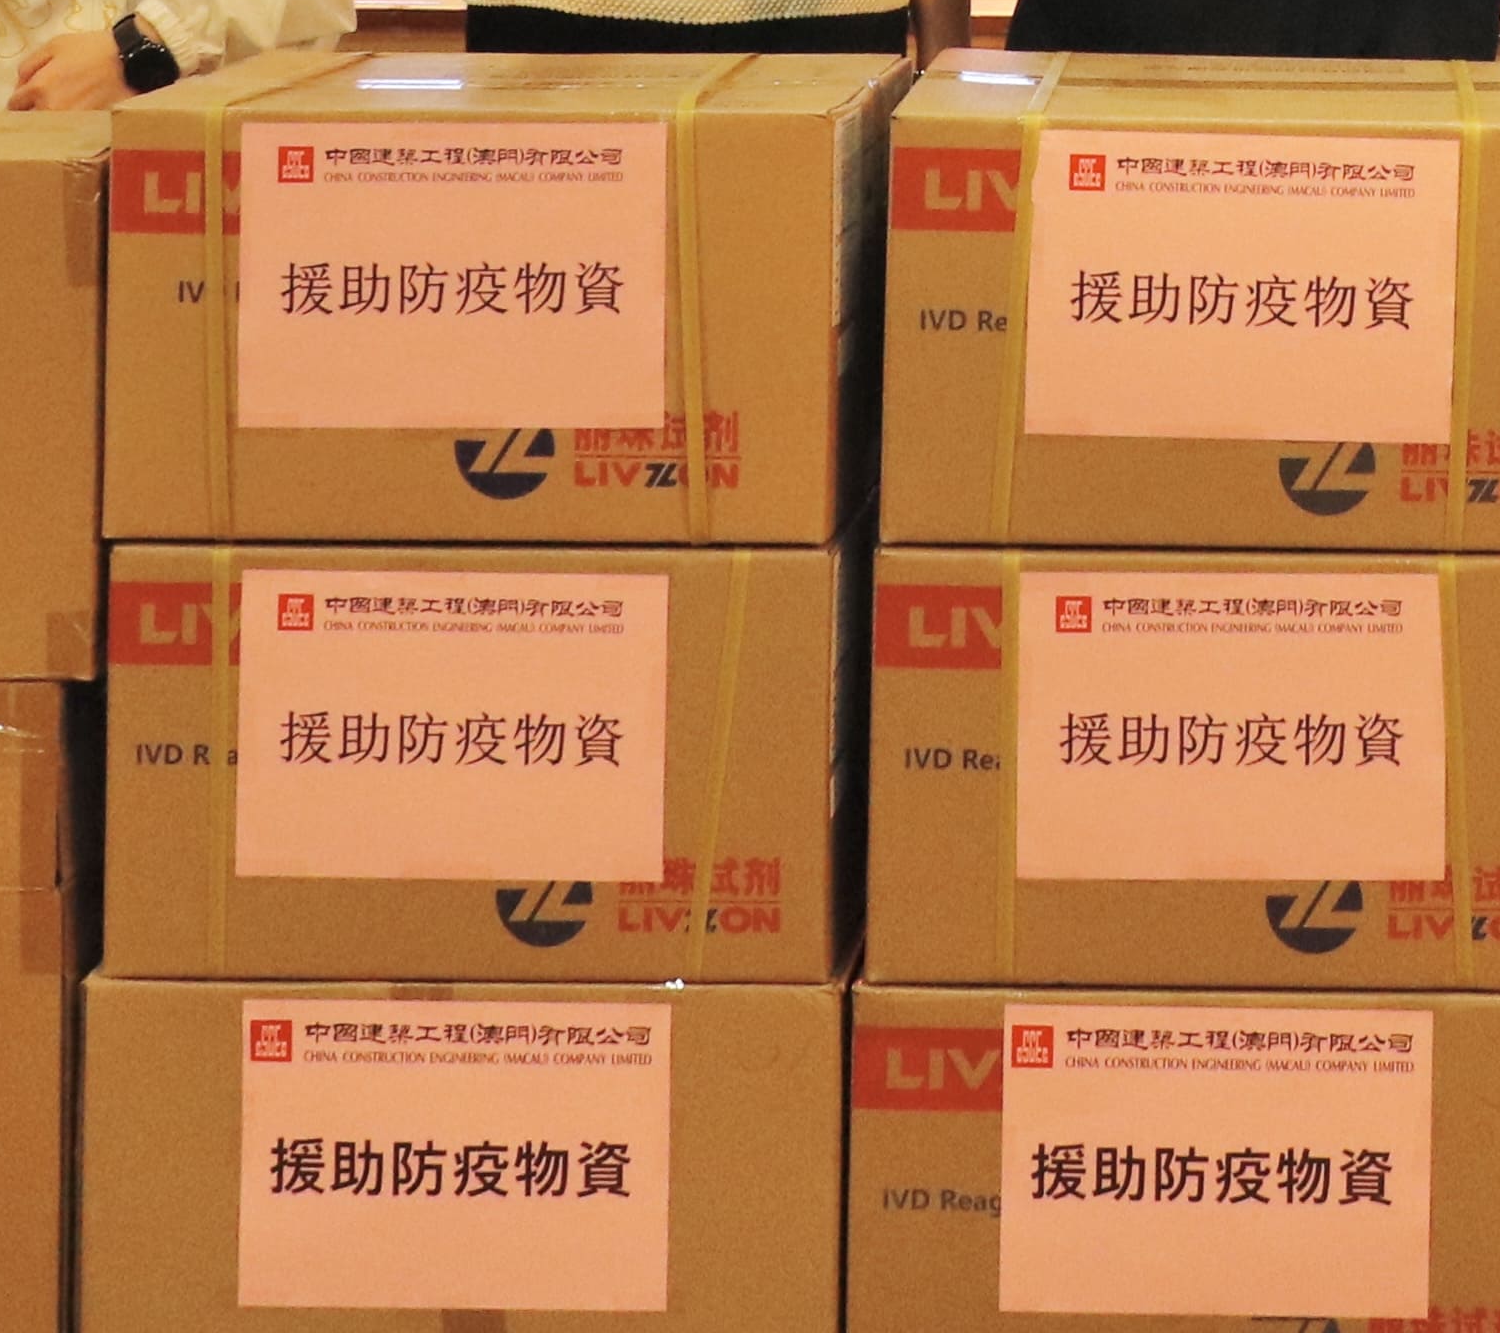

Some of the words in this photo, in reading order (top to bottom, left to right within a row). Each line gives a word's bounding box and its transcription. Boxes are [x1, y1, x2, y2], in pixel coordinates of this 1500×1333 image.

[280, 261, 624, 316] 援助防疫物資
[1070, 269, 1414, 331] 援助防疫物資
[919, 309, 966, 332] IVD
[135, 744, 183, 766] IVD
[279, 710, 623, 768] 援助防疫物資
[904, 748, 952, 769] IVD
[1059, 712, 1403, 767] 援助防疫物資
[269, 1136, 631, 1198] 援助防疫物資
[1030, 1142, 1393, 1206] 援助防疫物資
[883, 1188, 930, 1212] IVD
